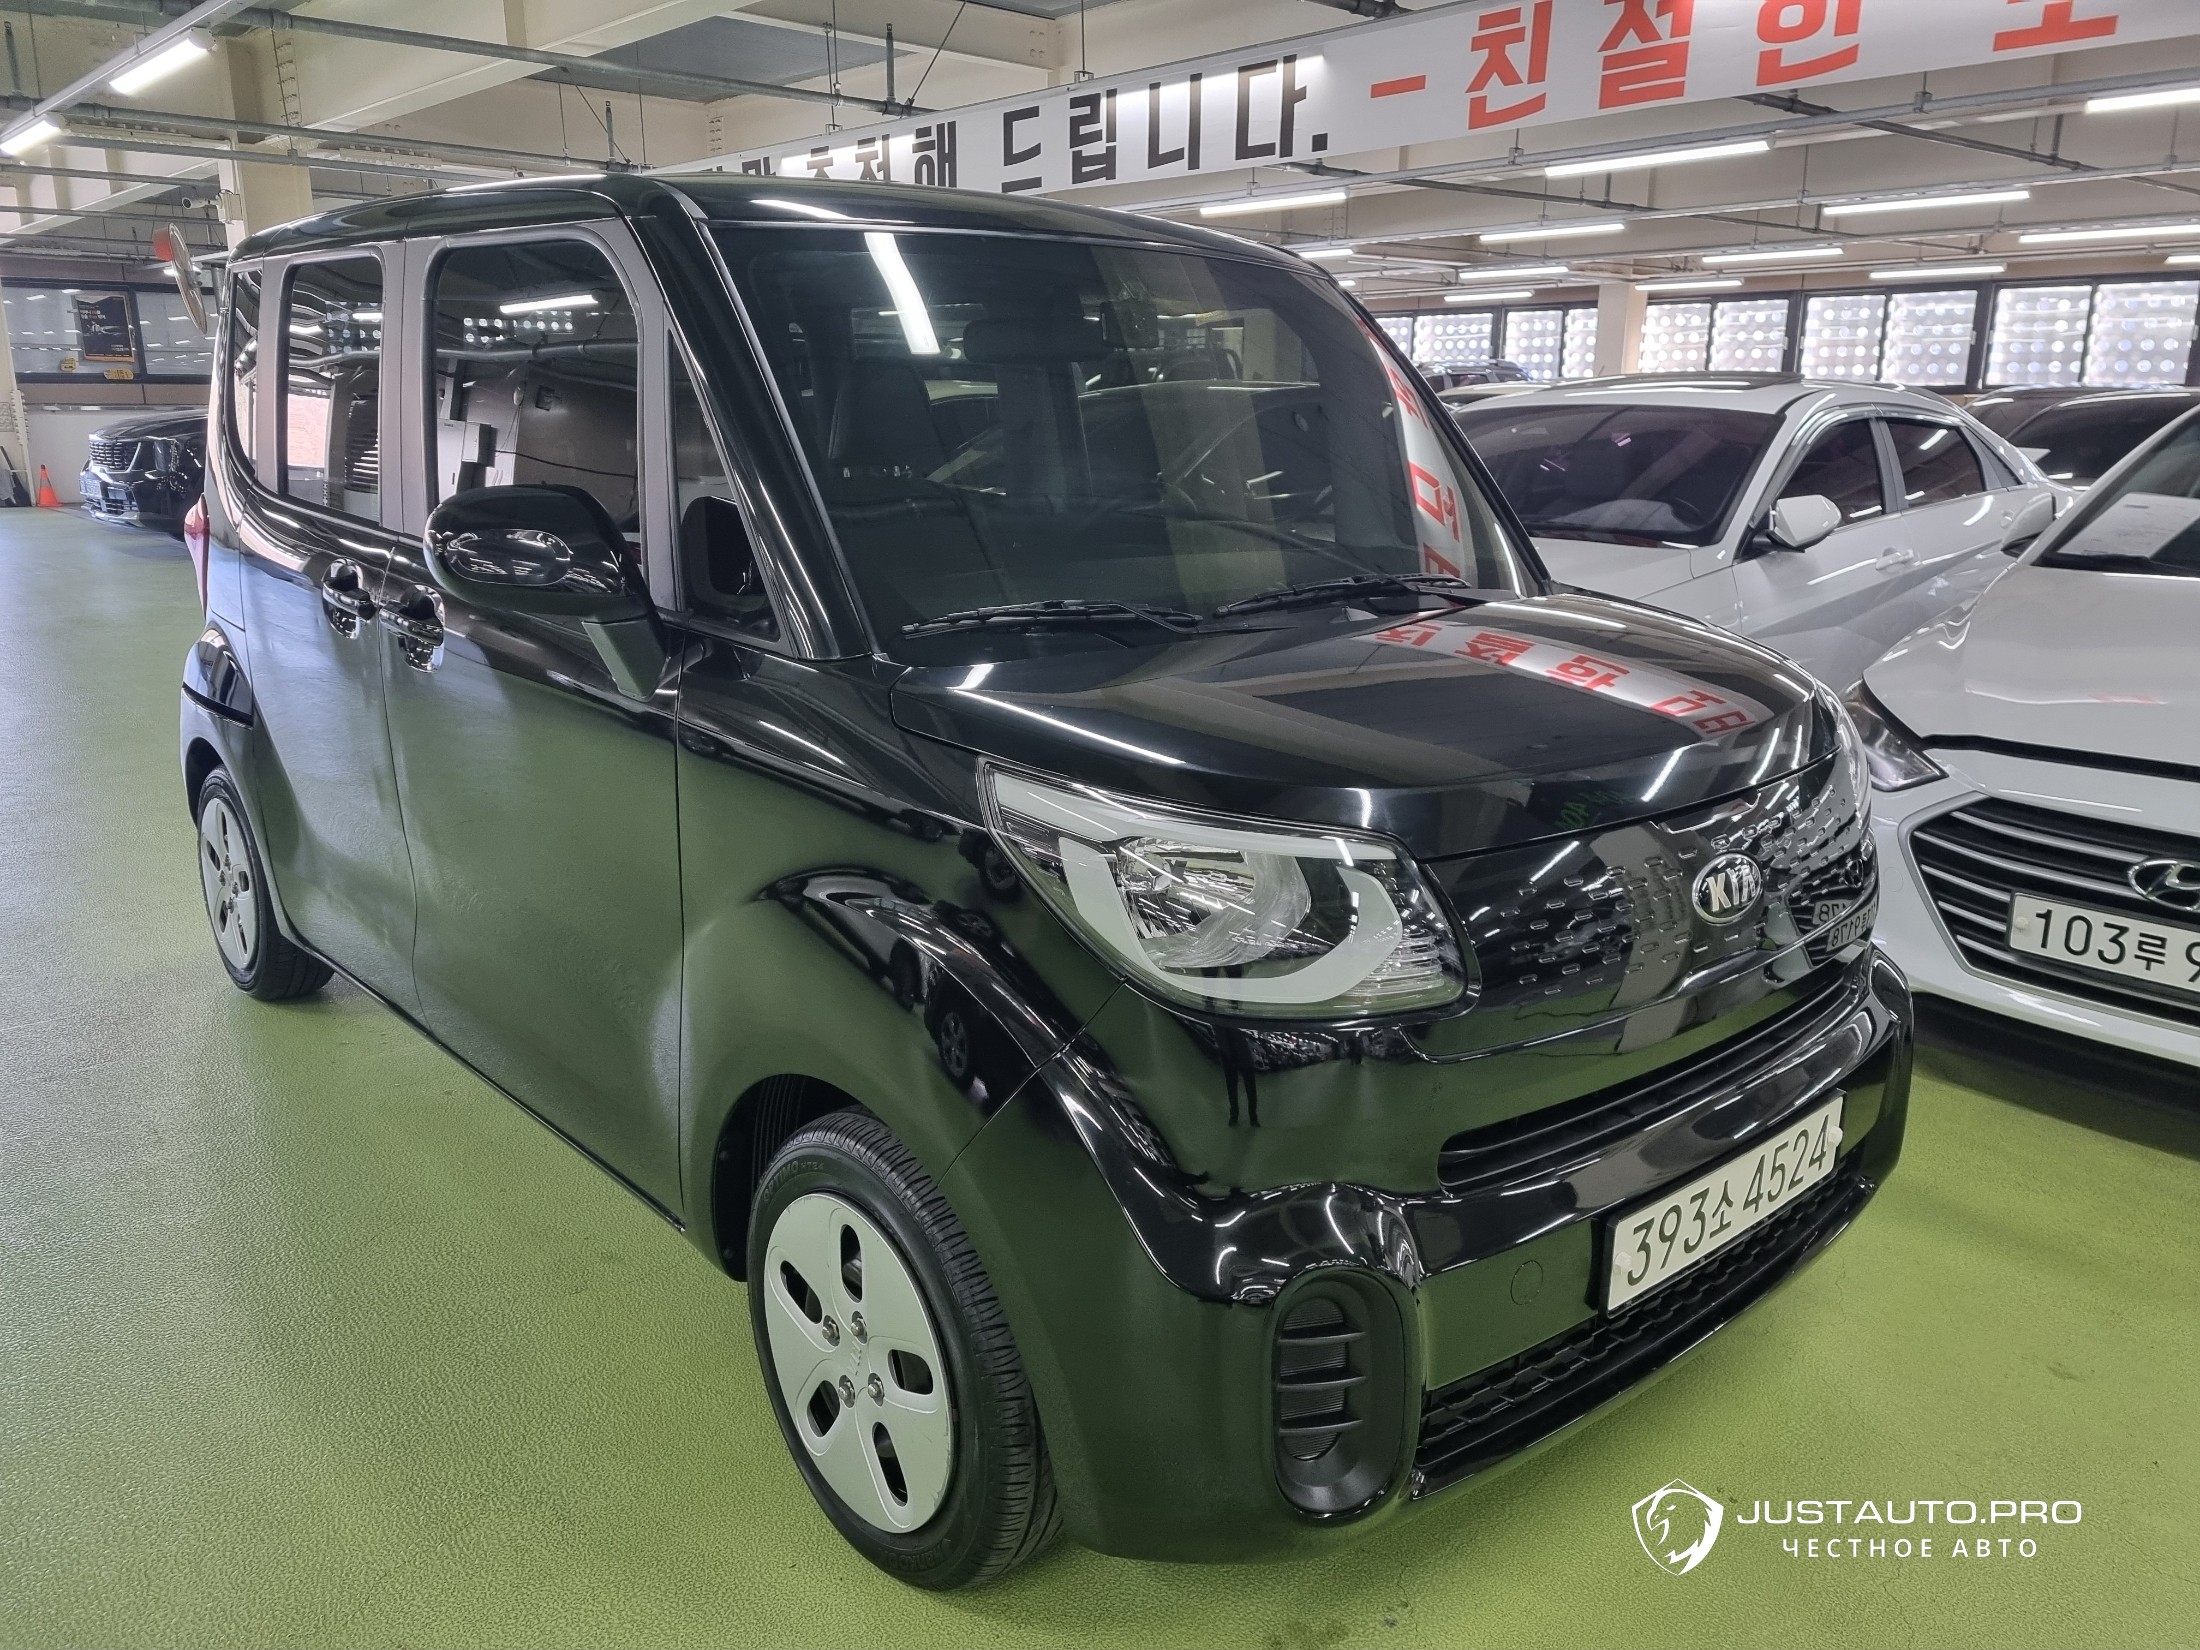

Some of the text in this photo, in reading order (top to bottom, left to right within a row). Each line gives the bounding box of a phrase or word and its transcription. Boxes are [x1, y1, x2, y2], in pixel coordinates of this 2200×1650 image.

[1705, 864, 1756, 912] KIA
[2035, 908, 2168, 971] 103루
[1627, 1114, 1829, 1287] 393소 4524
